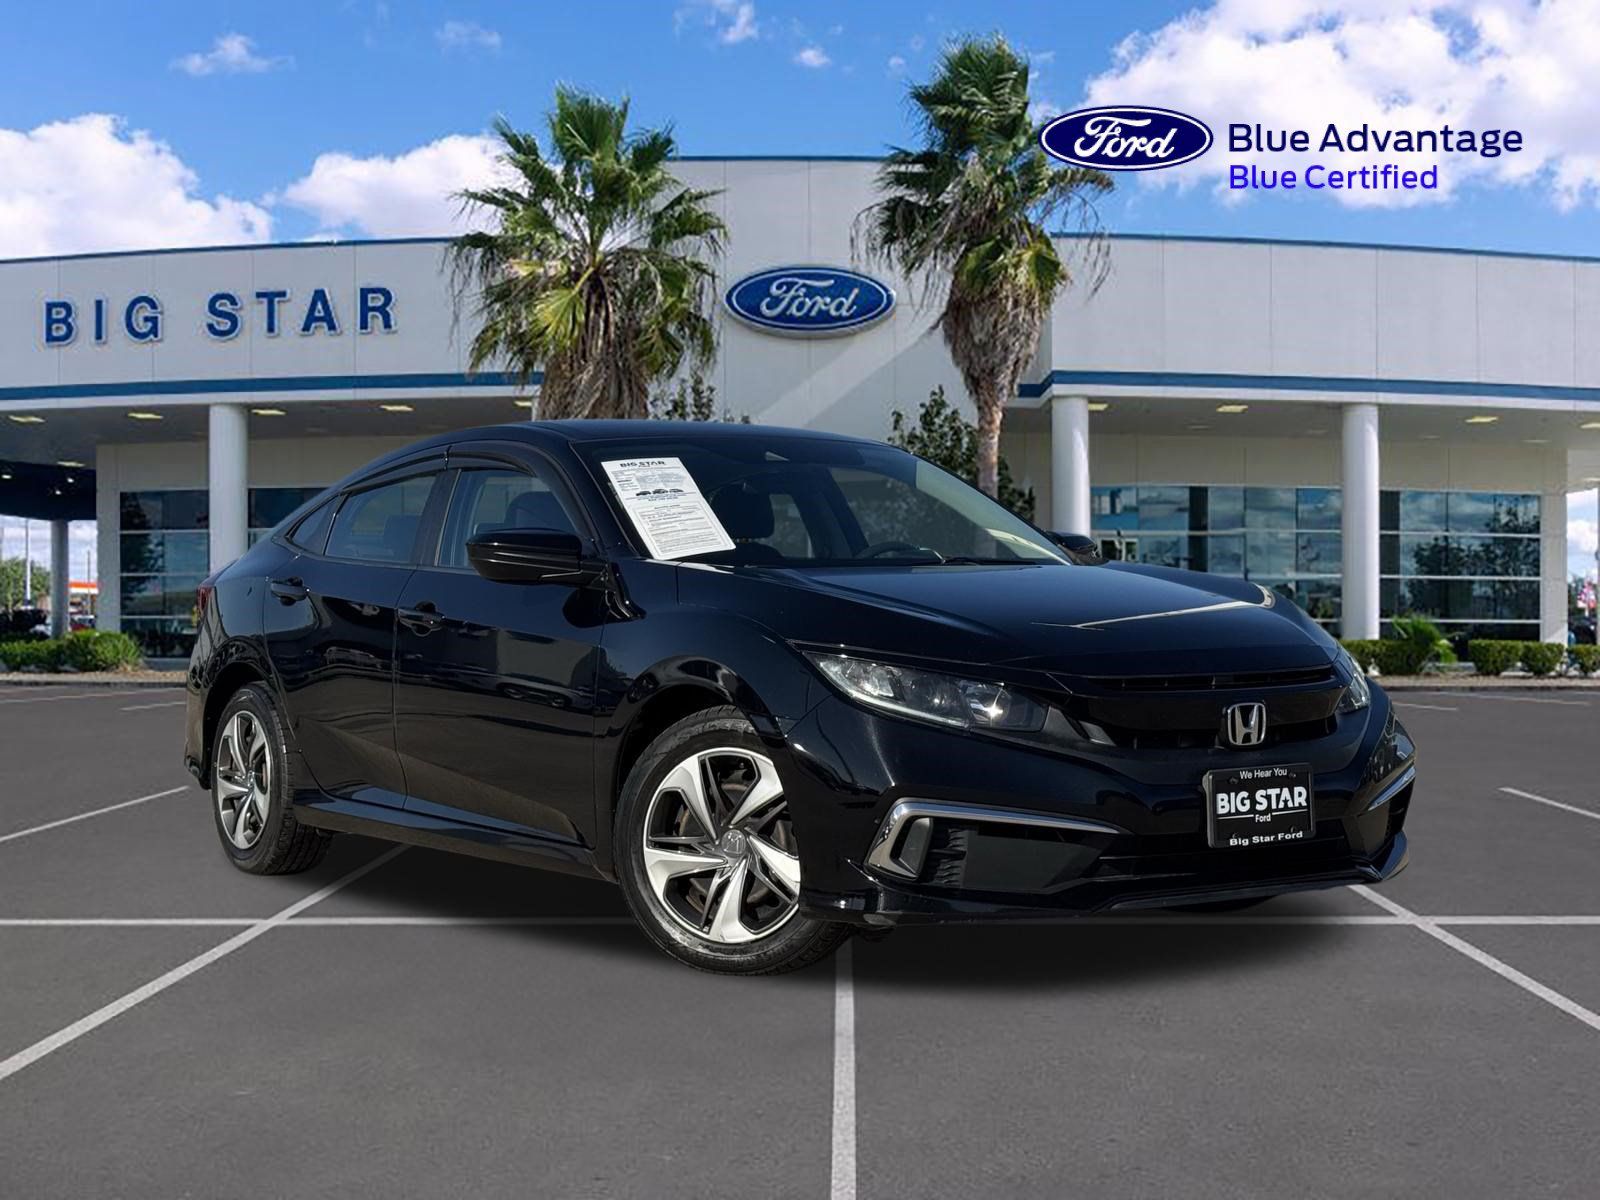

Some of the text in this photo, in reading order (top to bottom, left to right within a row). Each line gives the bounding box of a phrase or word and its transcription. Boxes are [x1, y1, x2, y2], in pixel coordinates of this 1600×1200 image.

[760, 277, 859, 317] Ford
[44, 286, 396, 346] BIG STAR
[1240, 768, 1288, 779] We Hear You
[1216, 786, 1307, 814] BIG STAR
[1255, 813, 1271, 823] Ford
[1230, 831, 1303, 846] Big Star Ford
